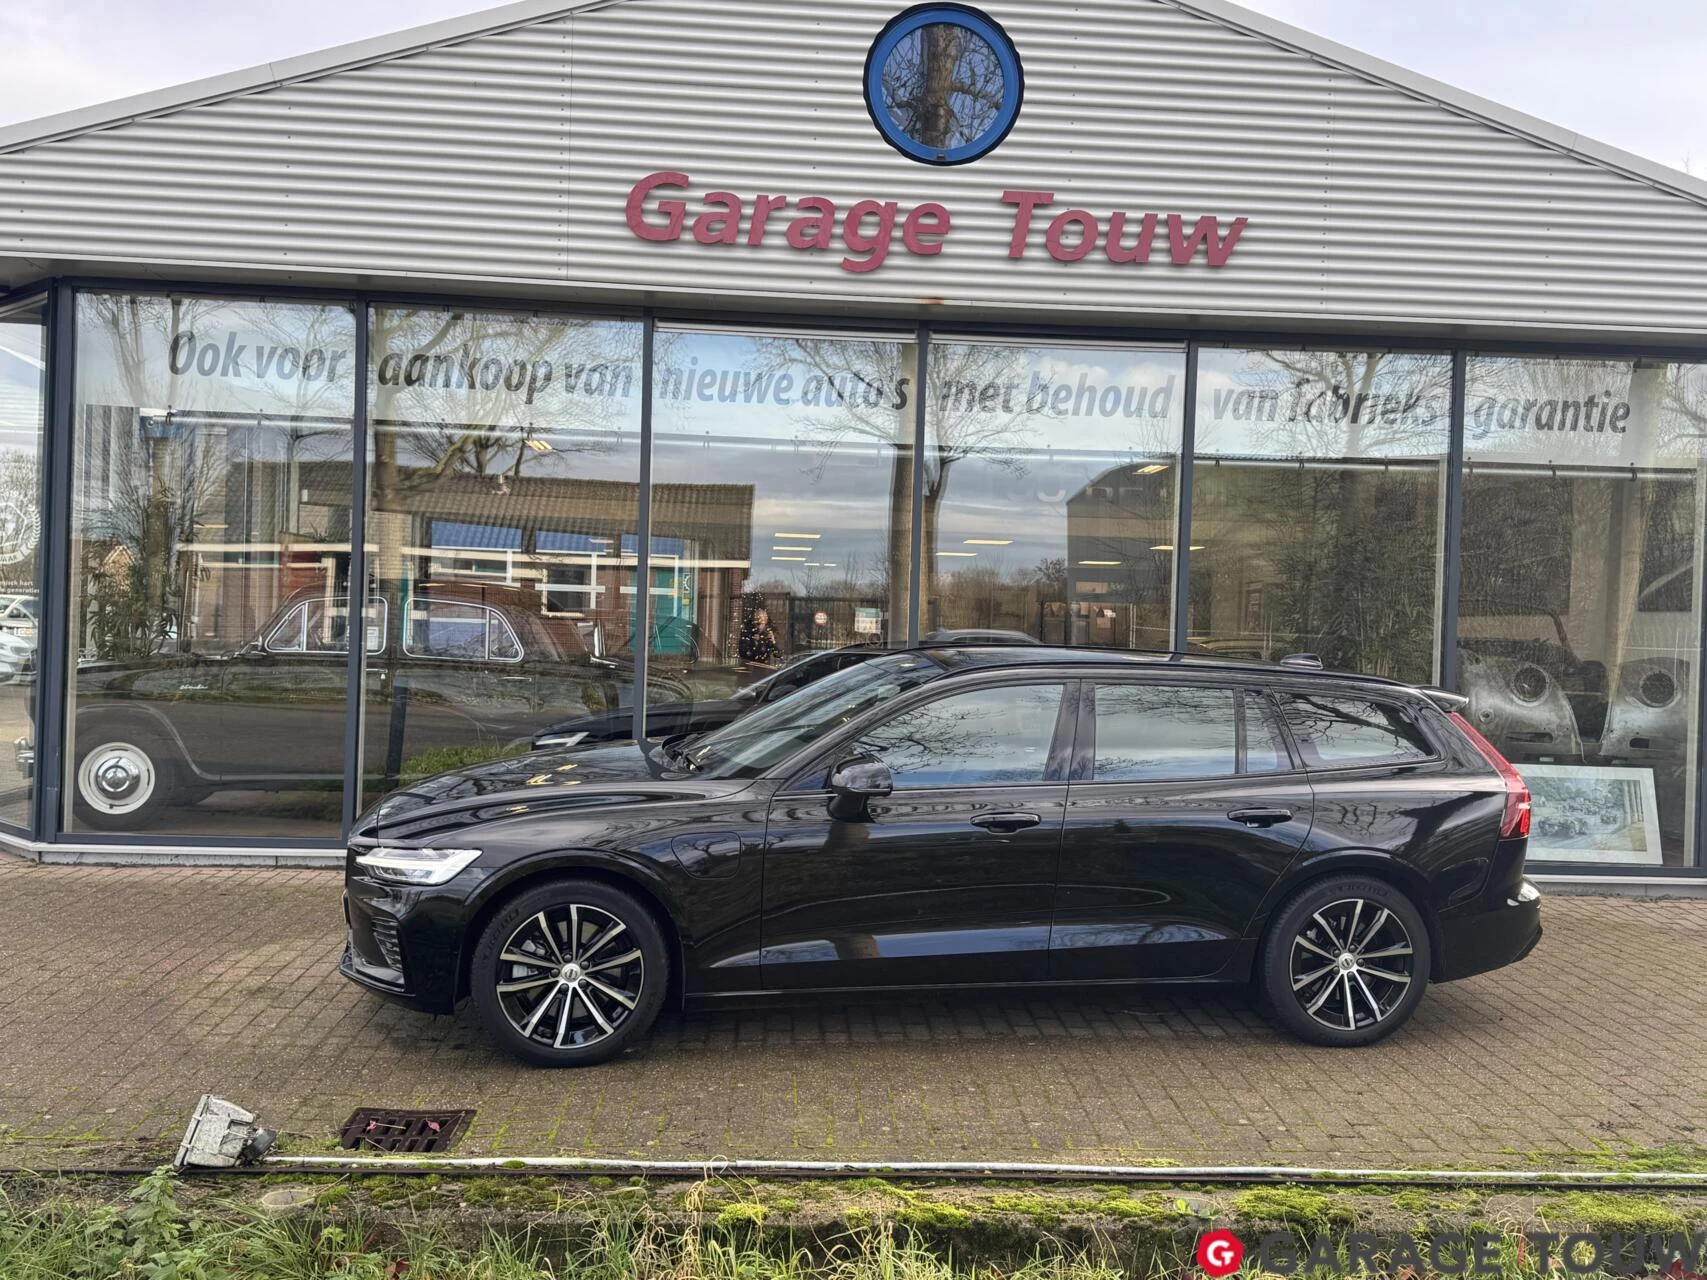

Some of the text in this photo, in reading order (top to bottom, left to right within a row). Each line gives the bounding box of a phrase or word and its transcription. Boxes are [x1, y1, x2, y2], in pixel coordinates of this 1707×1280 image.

[625, 171, 1248, 273] Garage Touw
[168, 331, 247, 377] Ook
[256, 345, 348, 383] voor
[378, 344, 553, 405] aankoop
[564, 361, 634, 397] van
[659, 356, 794, 405] nieuwe
[801, 367, 910, 410] auto's
[940, 377, 1021, 414] met
[1026, 371, 1177, 419] behoud
[1213, 388, 1279, 422] van
[1472, 390, 1631, 440] garantie
